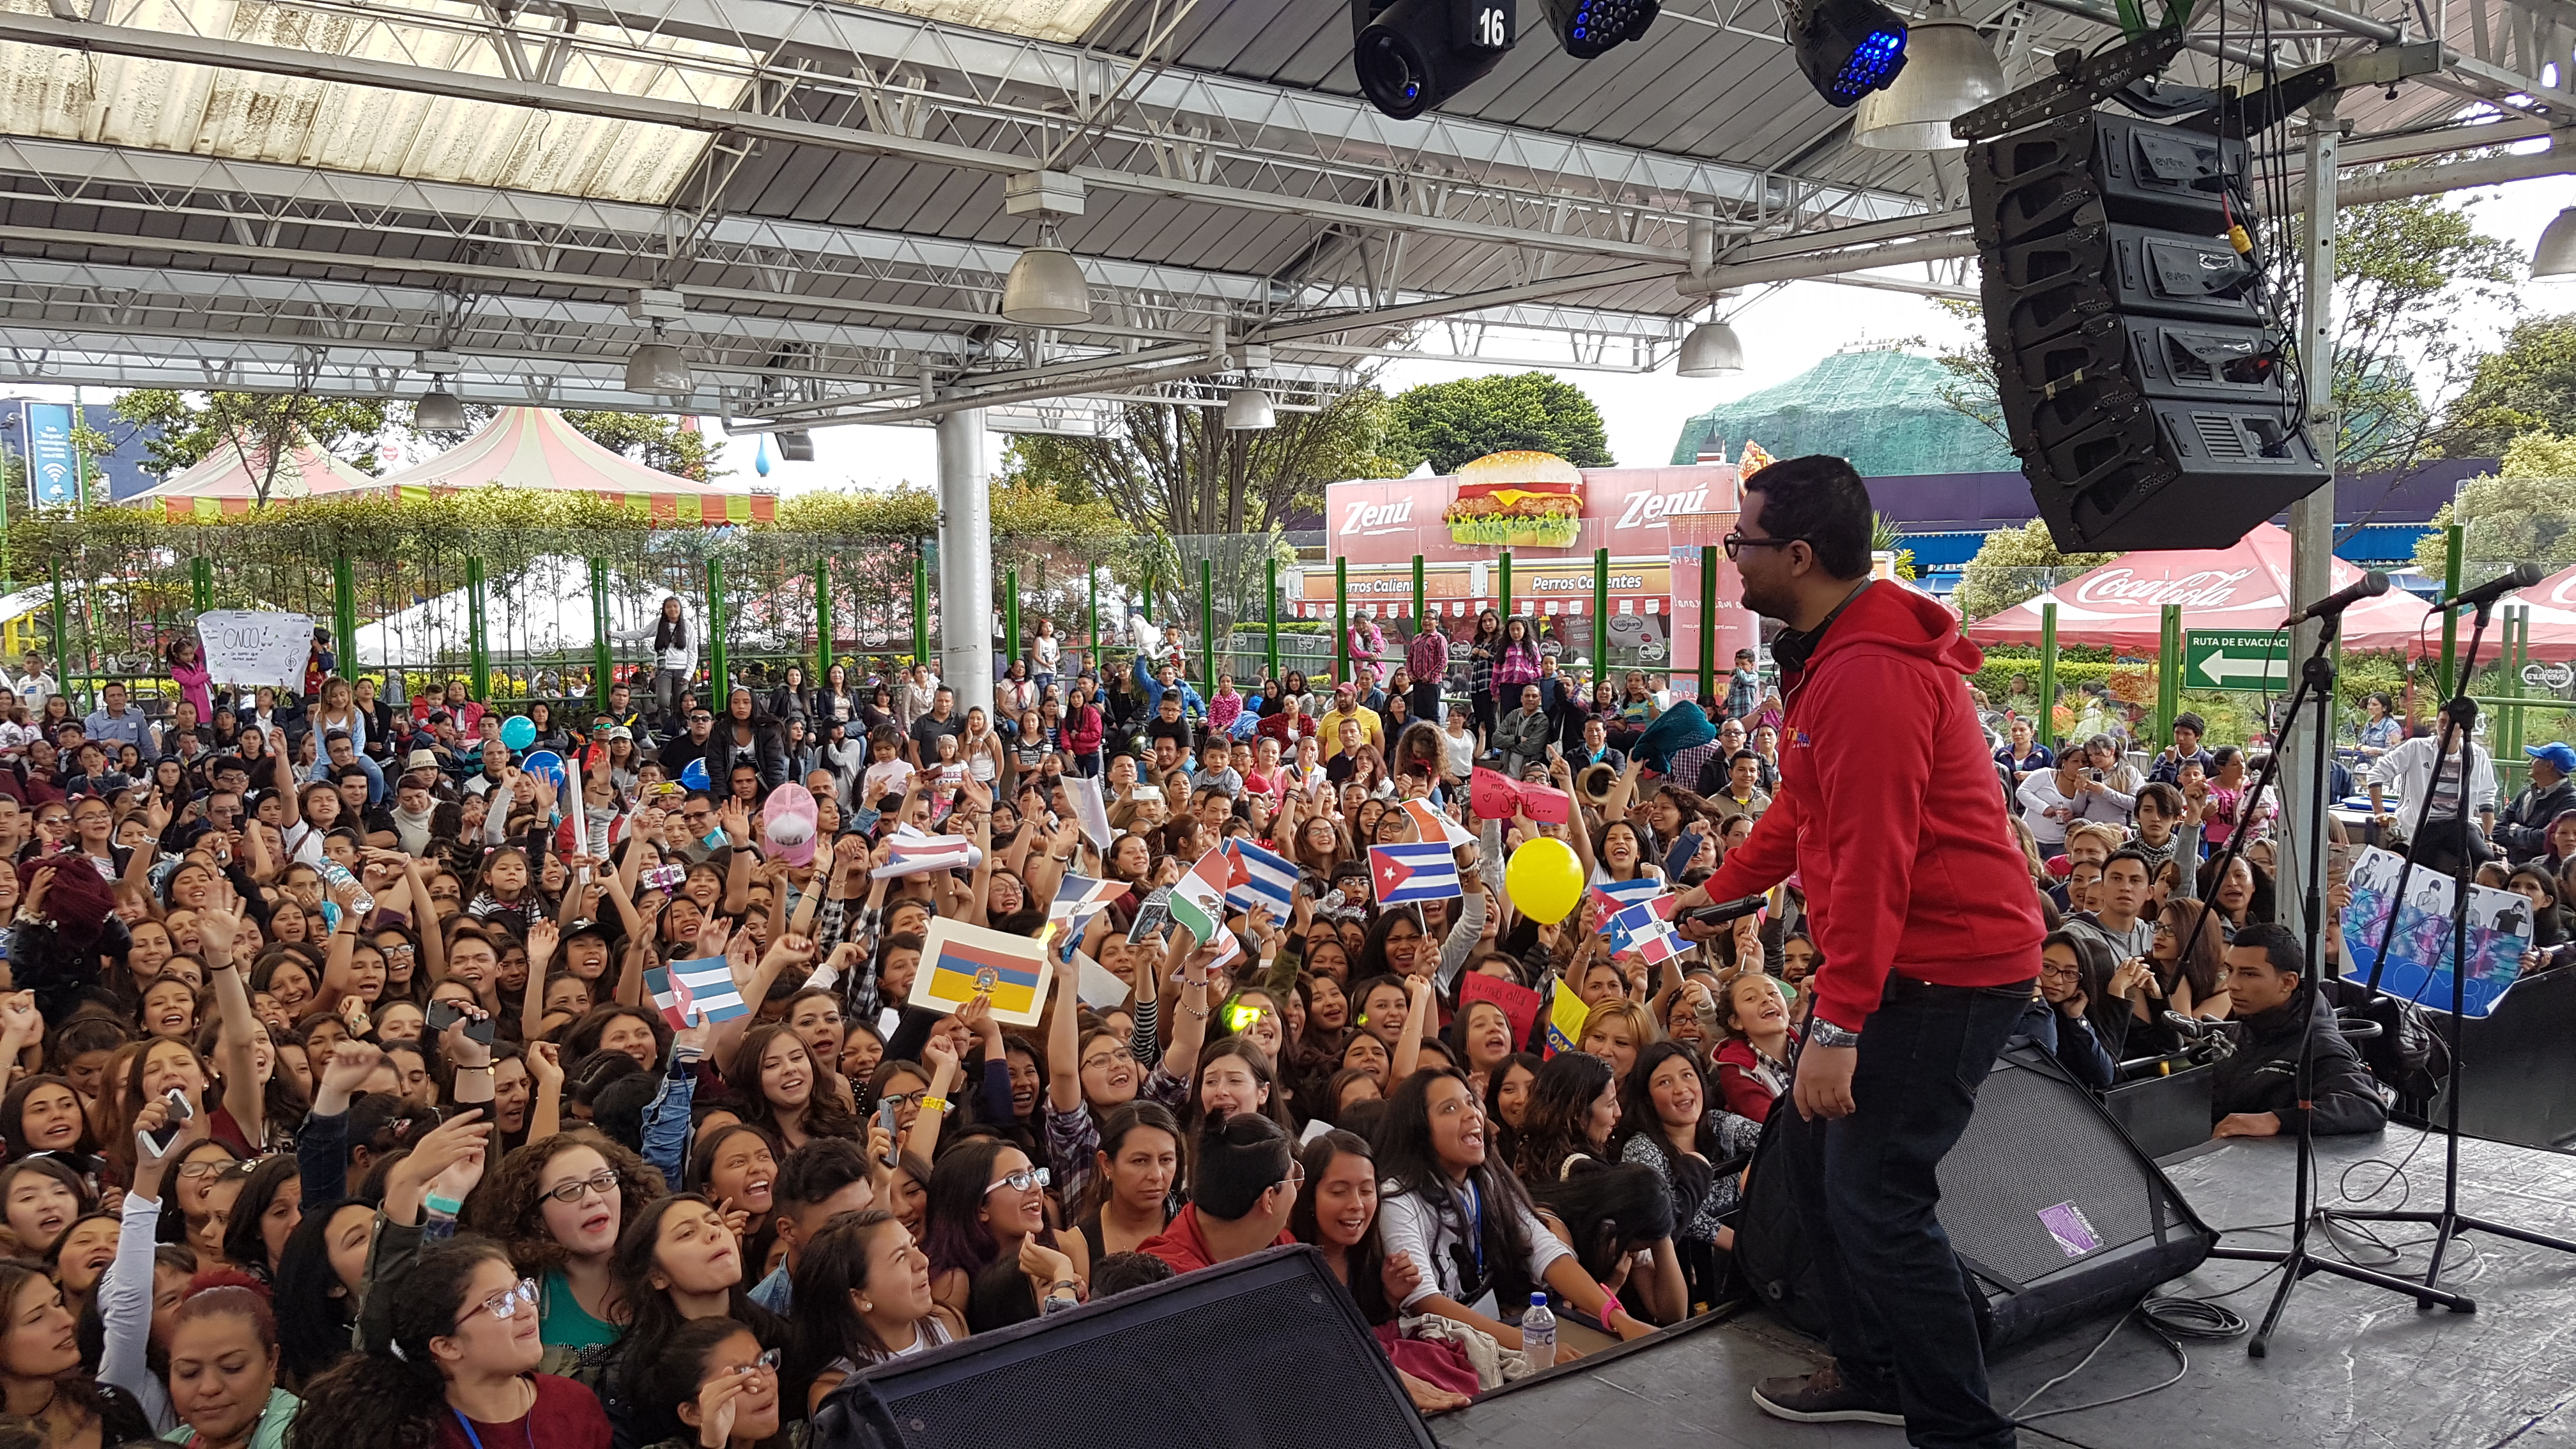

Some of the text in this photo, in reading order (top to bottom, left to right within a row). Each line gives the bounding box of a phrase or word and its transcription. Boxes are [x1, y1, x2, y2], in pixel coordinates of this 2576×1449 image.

[1480, 8, 1505, 46] 16
[1338, 495, 1414, 535] Zenú
[1614, 482, 1710, 530] Zenú
[1335, 578, 1429, 594] erros Calients
[1532, 574, 1643, 592] Perros Caentes
[2076, 565, 2258, 606] Coca-Cola
[223, 627, 260, 649] CNCO
[2193, 637, 2219, 646] RUTA
[2221, 637, 2235, 646] DE
